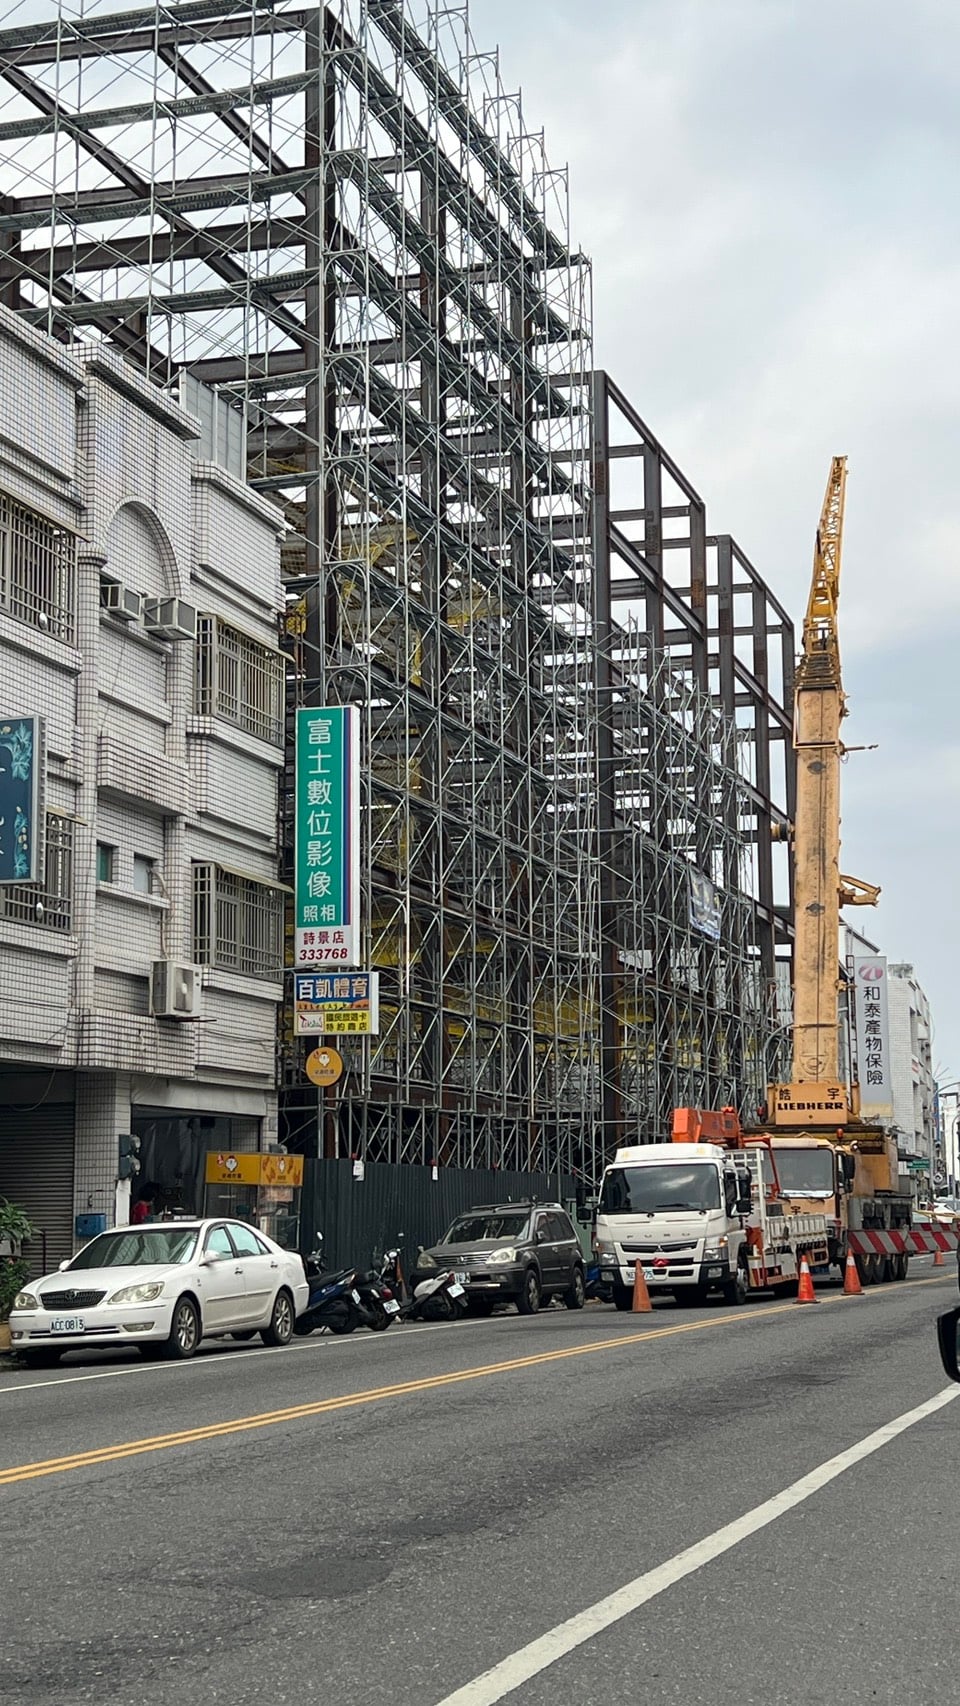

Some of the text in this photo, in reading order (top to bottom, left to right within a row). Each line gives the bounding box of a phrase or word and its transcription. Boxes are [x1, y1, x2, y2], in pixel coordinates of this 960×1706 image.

[307, 718, 332, 897] 富士數位影像
[303, 904, 336, 922] 照相
[303, 930, 345, 945] 詩景店
[299, 947, 348, 961] 333768
[298, 977, 368, 1000] 百凱體育
[863, 985, 884, 1086] 和泰產物保險
[777, 1102, 844, 1110] LIEBHERR
